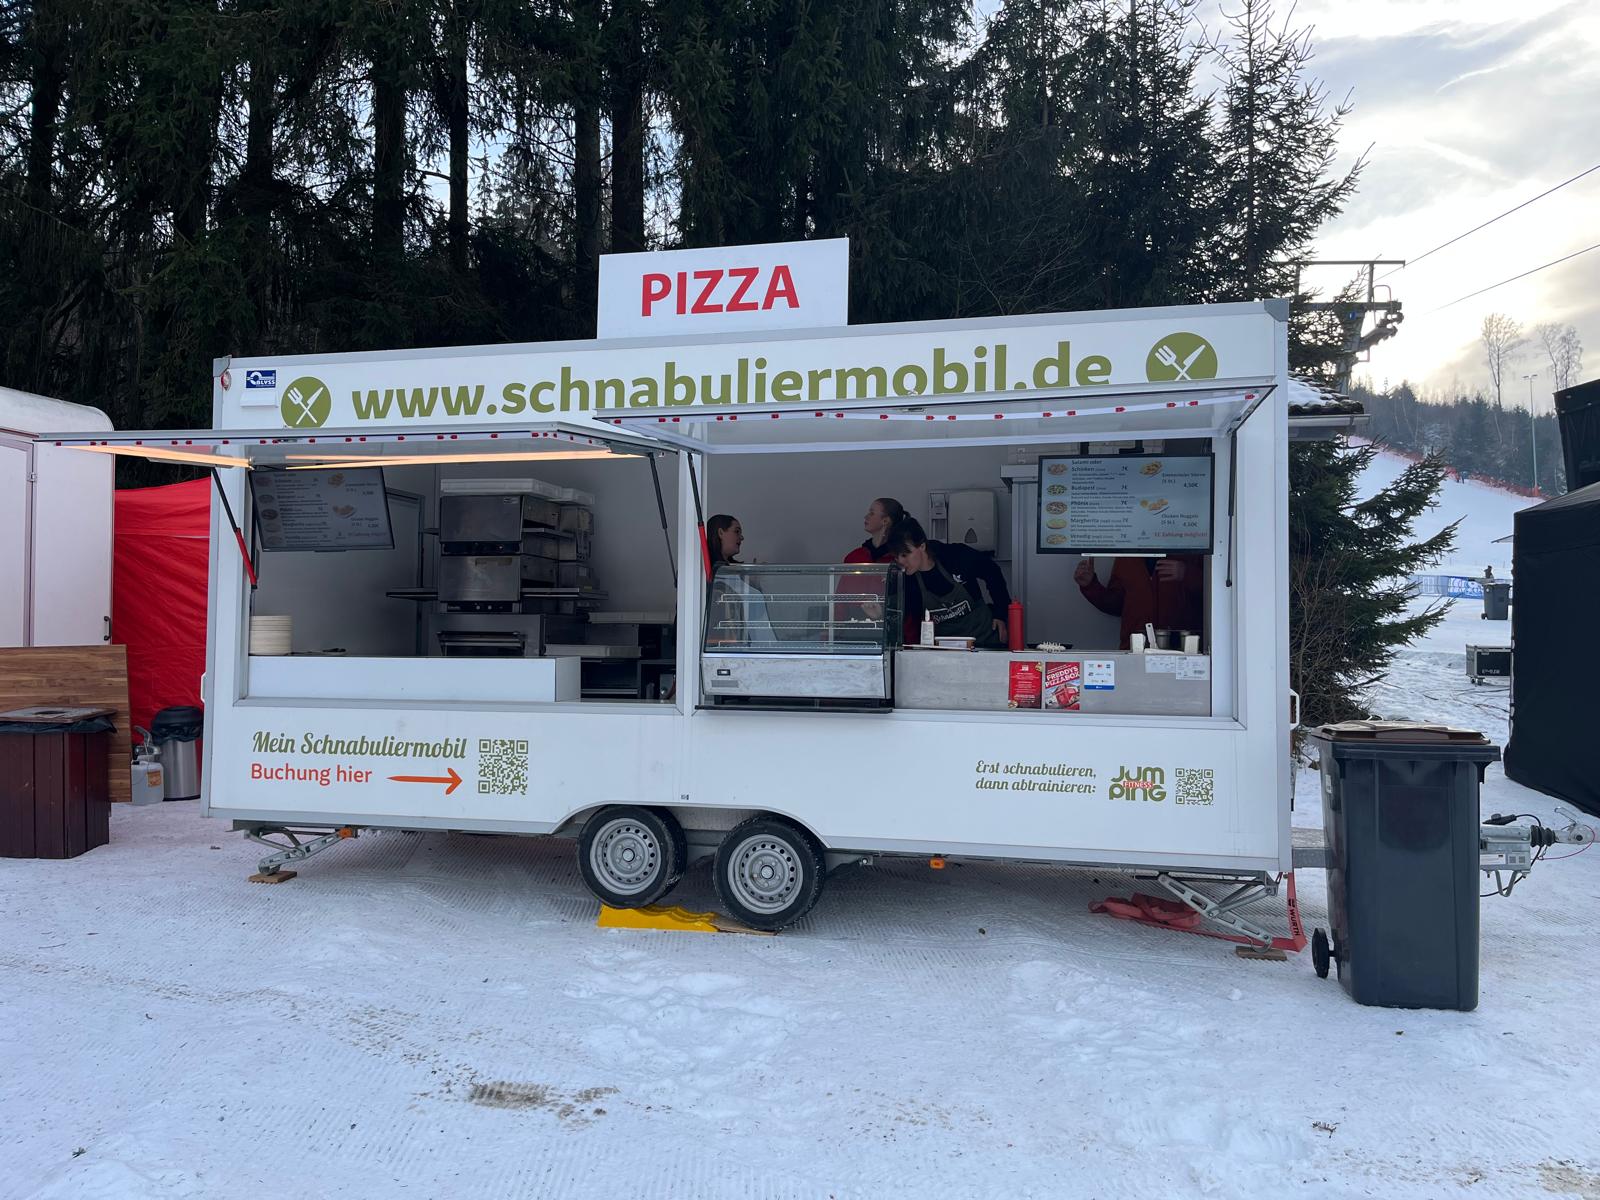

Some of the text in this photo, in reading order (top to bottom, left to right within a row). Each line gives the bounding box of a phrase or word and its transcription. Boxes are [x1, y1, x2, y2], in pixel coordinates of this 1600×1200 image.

[642, 265, 800, 316] PIZZA
[352, 341, 1112, 420] www.schnabuliermobil.de
[1045, 671, 1081, 688] PIZZABOX
[252, 731, 467, 759] Mein Schnabuliermobil
[251, 763, 373, 786] Buchung hier
[976, 760, 1096, 778] Erst schnabulieren,
[976, 777, 1096, 794] dann abtrainieren:
[1124, 781, 1153, 789] FITNESS
